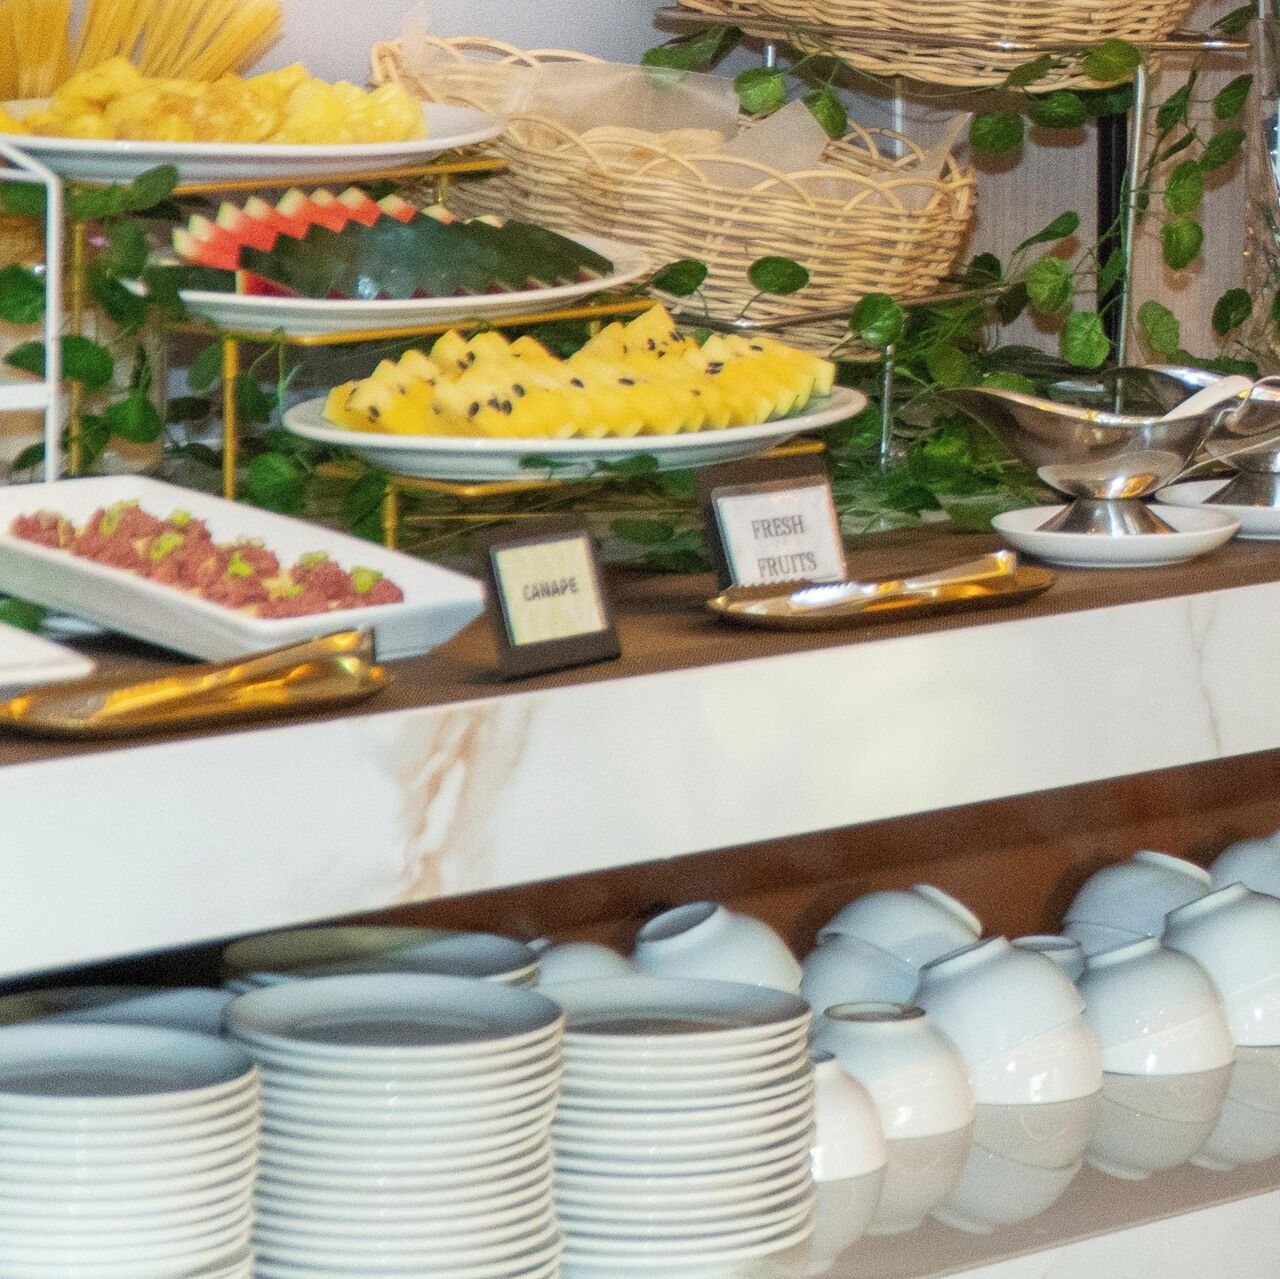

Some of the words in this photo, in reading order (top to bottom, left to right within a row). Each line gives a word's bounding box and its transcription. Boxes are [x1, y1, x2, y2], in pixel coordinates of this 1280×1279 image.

[751, 515, 806, 540] FRESH
[757, 551, 818, 578] FRUITS
[521, 576, 579, 602] CANAPE
